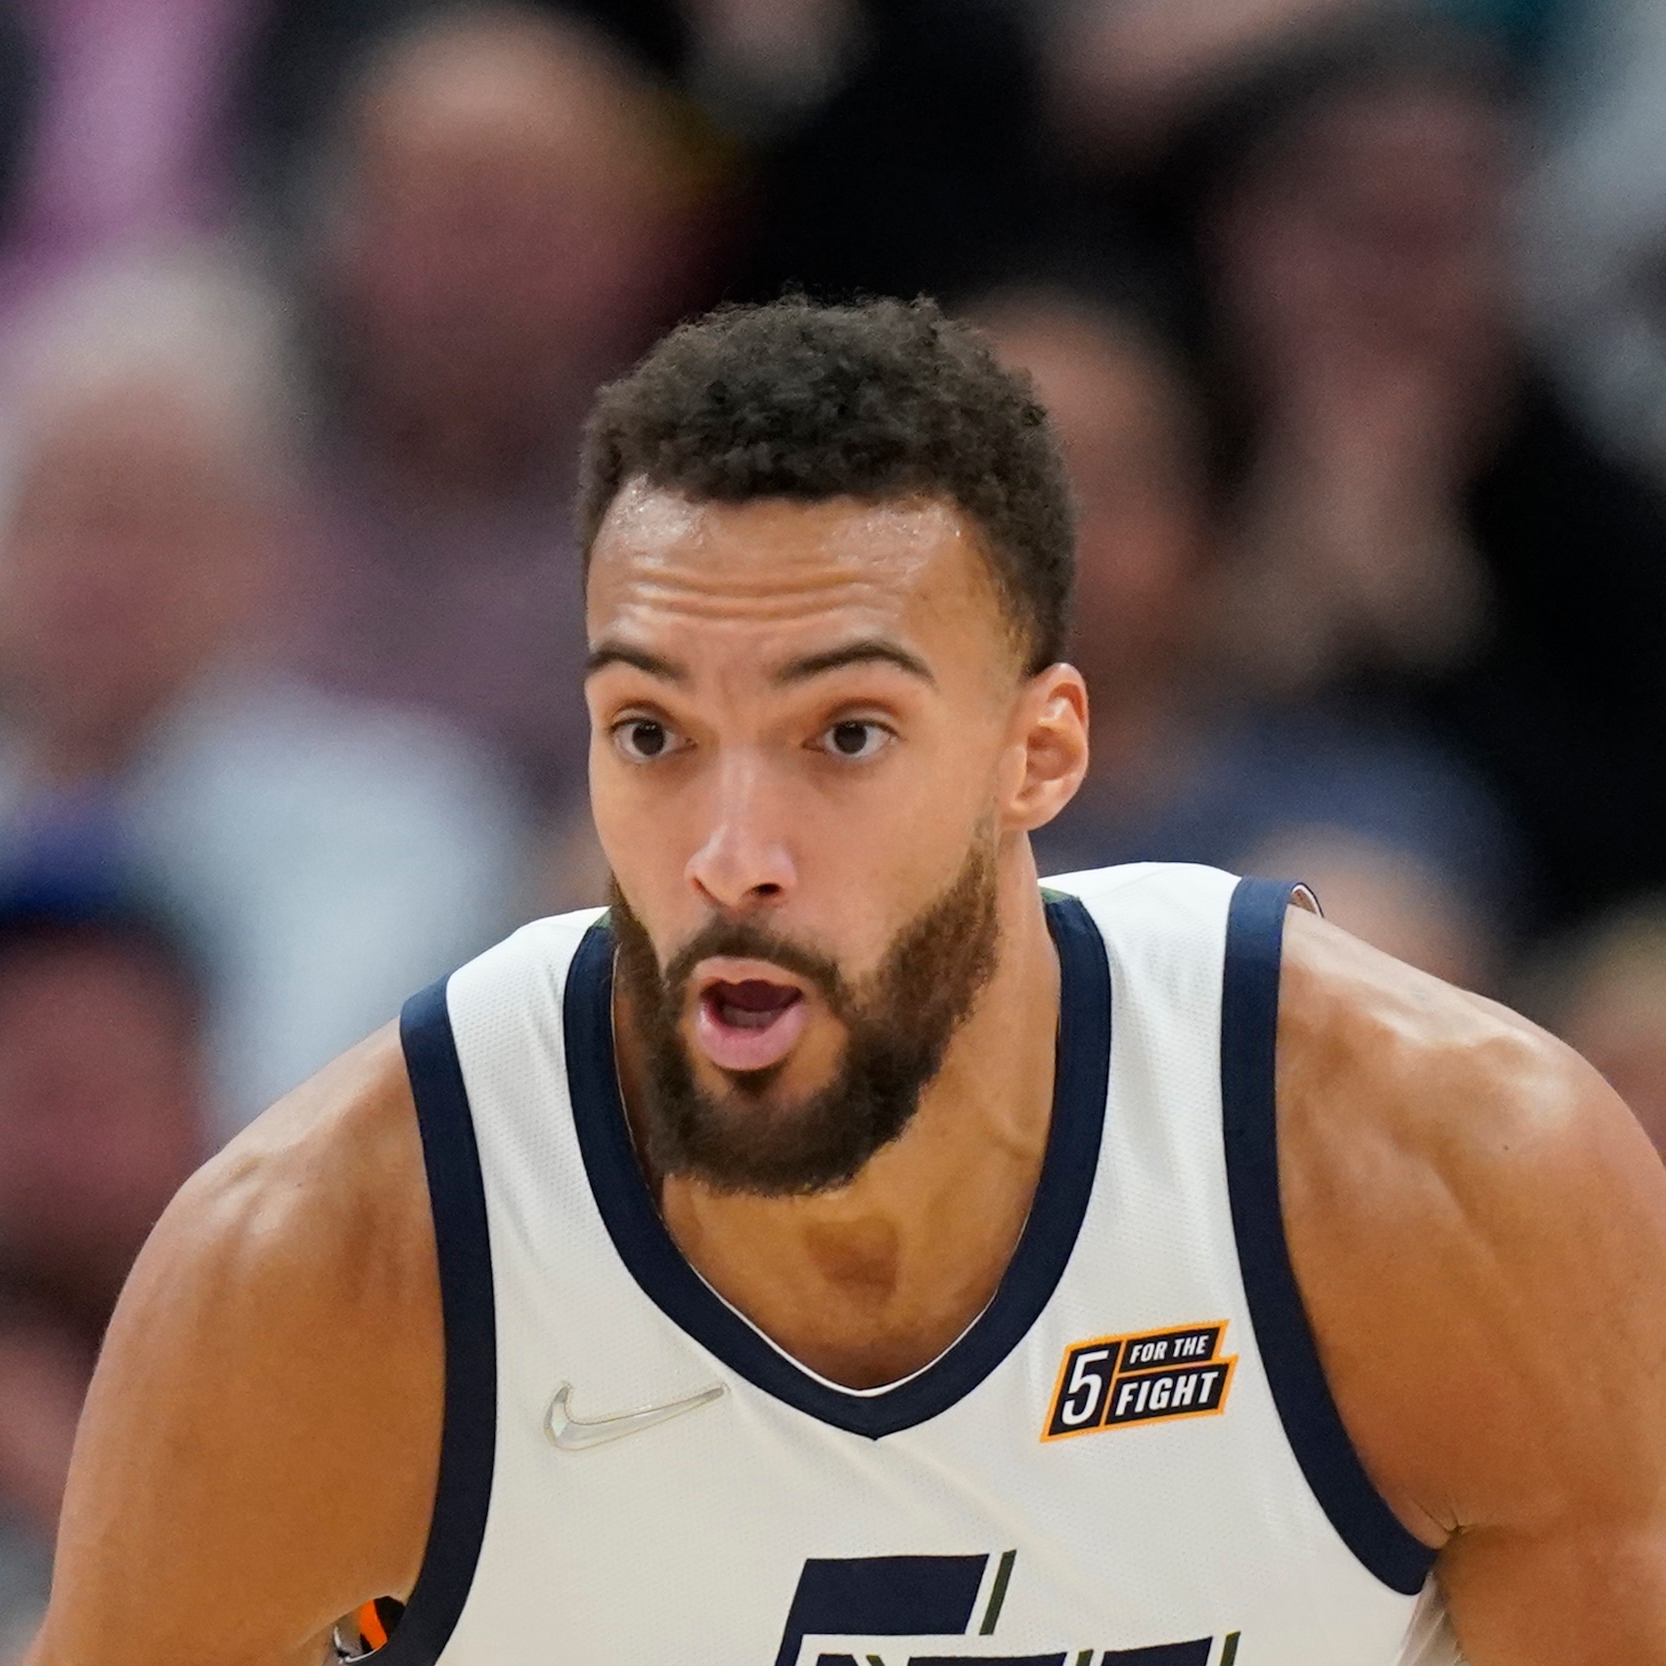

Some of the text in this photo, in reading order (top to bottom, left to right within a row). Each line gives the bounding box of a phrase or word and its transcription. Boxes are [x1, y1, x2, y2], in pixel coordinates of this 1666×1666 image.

[1129, 1334, 1209, 1364] FOR THE
[1061, 1350, 1109, 1426] 5
[1115, 1371, 1219, 1416] FIGHT
